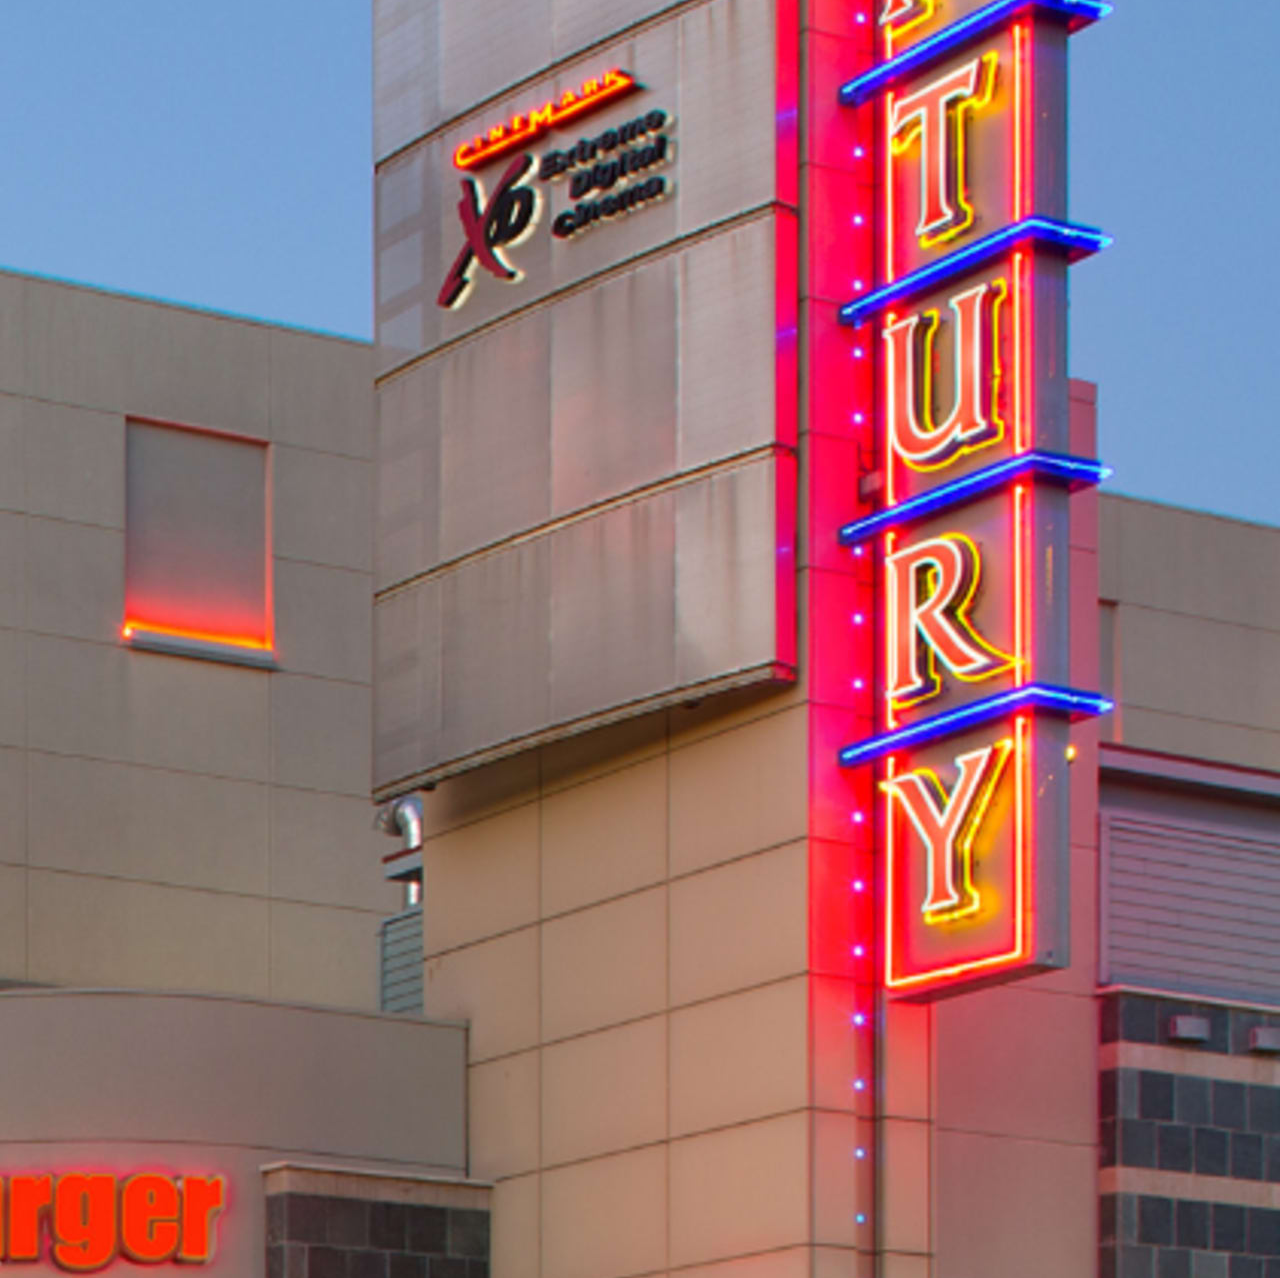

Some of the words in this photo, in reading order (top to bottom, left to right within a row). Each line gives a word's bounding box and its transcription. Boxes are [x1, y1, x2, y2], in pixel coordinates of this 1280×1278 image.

[453, 68, 634, 170] CINEMARK
[539, 109, 668, 181] Extreme
[569, 134, 668, 200] Digital
